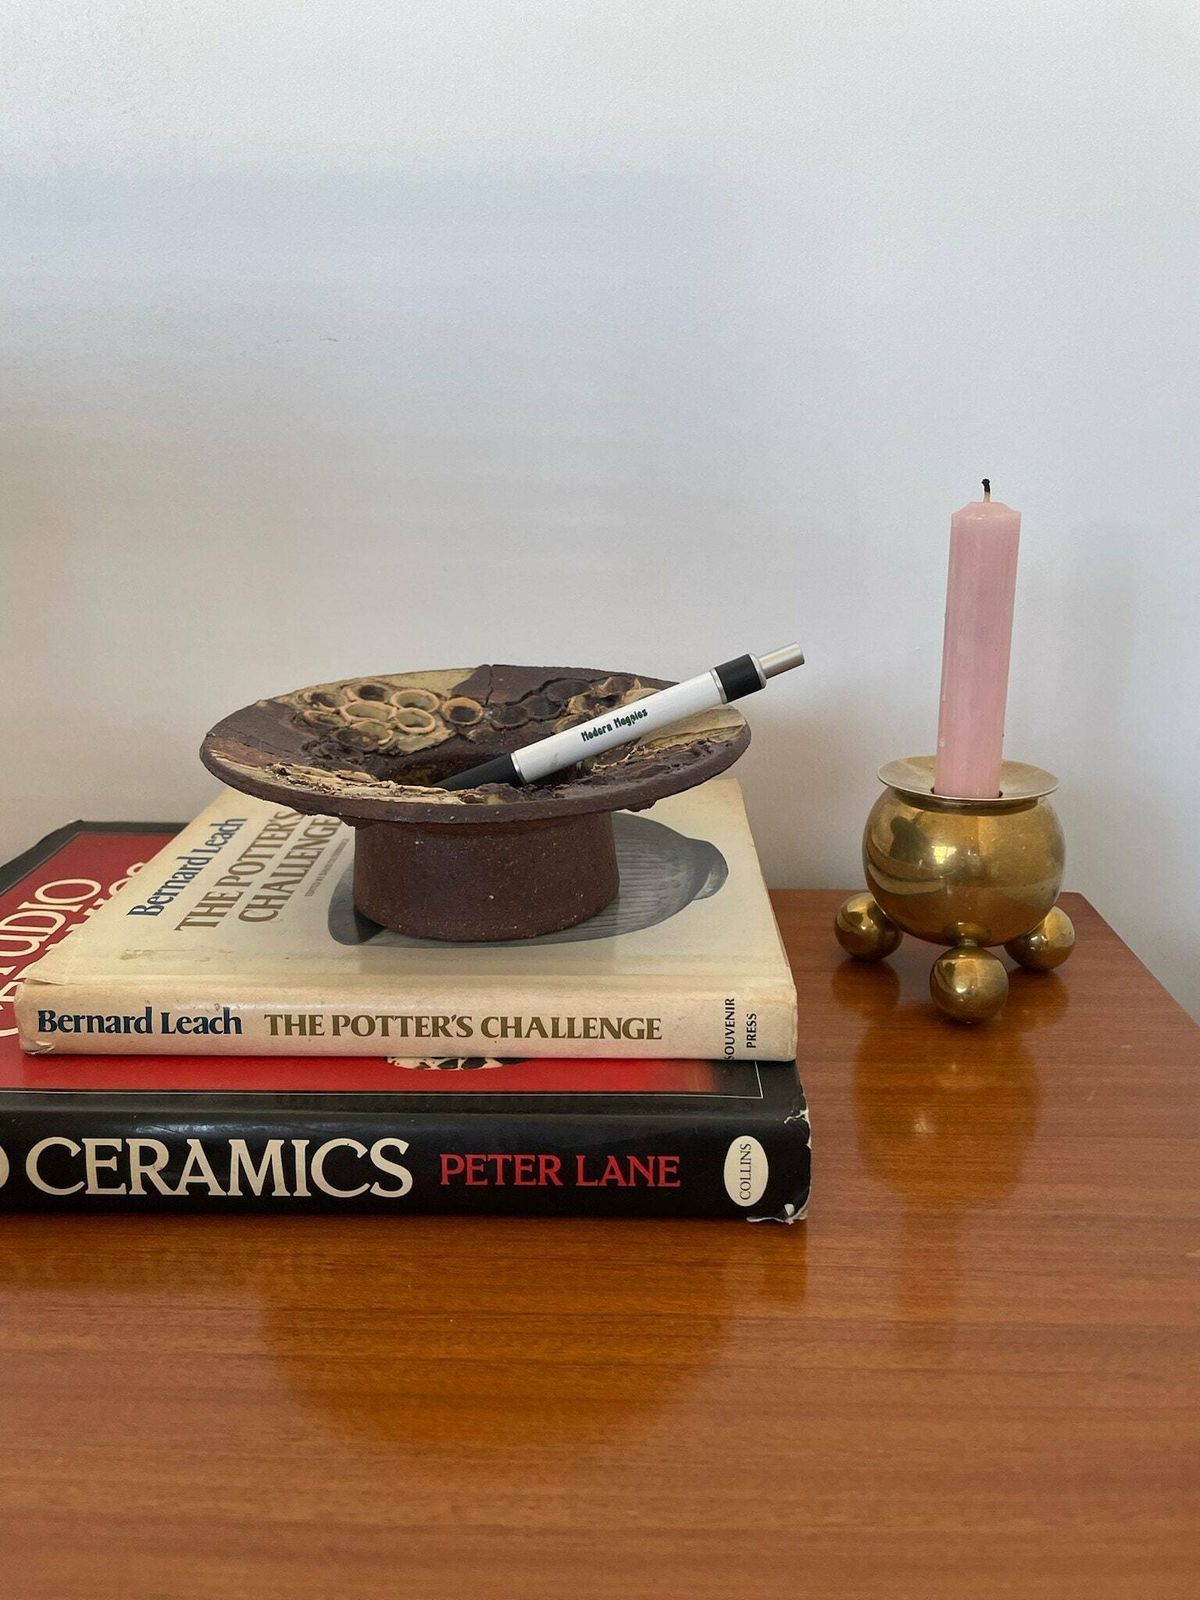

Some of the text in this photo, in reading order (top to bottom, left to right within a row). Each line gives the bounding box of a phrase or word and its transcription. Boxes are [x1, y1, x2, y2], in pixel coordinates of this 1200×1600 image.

[581, 708, 648, 742] Modern Magpies
[127, 817, 248, 917] Bernard Leach
[238, 818, 342, 923] CHALLENGE
[174, 890, 243, 931] THE
[37, 1006, 662, 1041] Bernard Leach THE POTTER'S CHALLENGE
[746, 1013, 757, 1048] PRESS
[25, 1136, 413, 1197] CERAMICS
[440, 1154, 563, 1187] PETER
[576, 1155, 681, 1188] LANE
[739, 1143, 752, 1200] COLLINS
